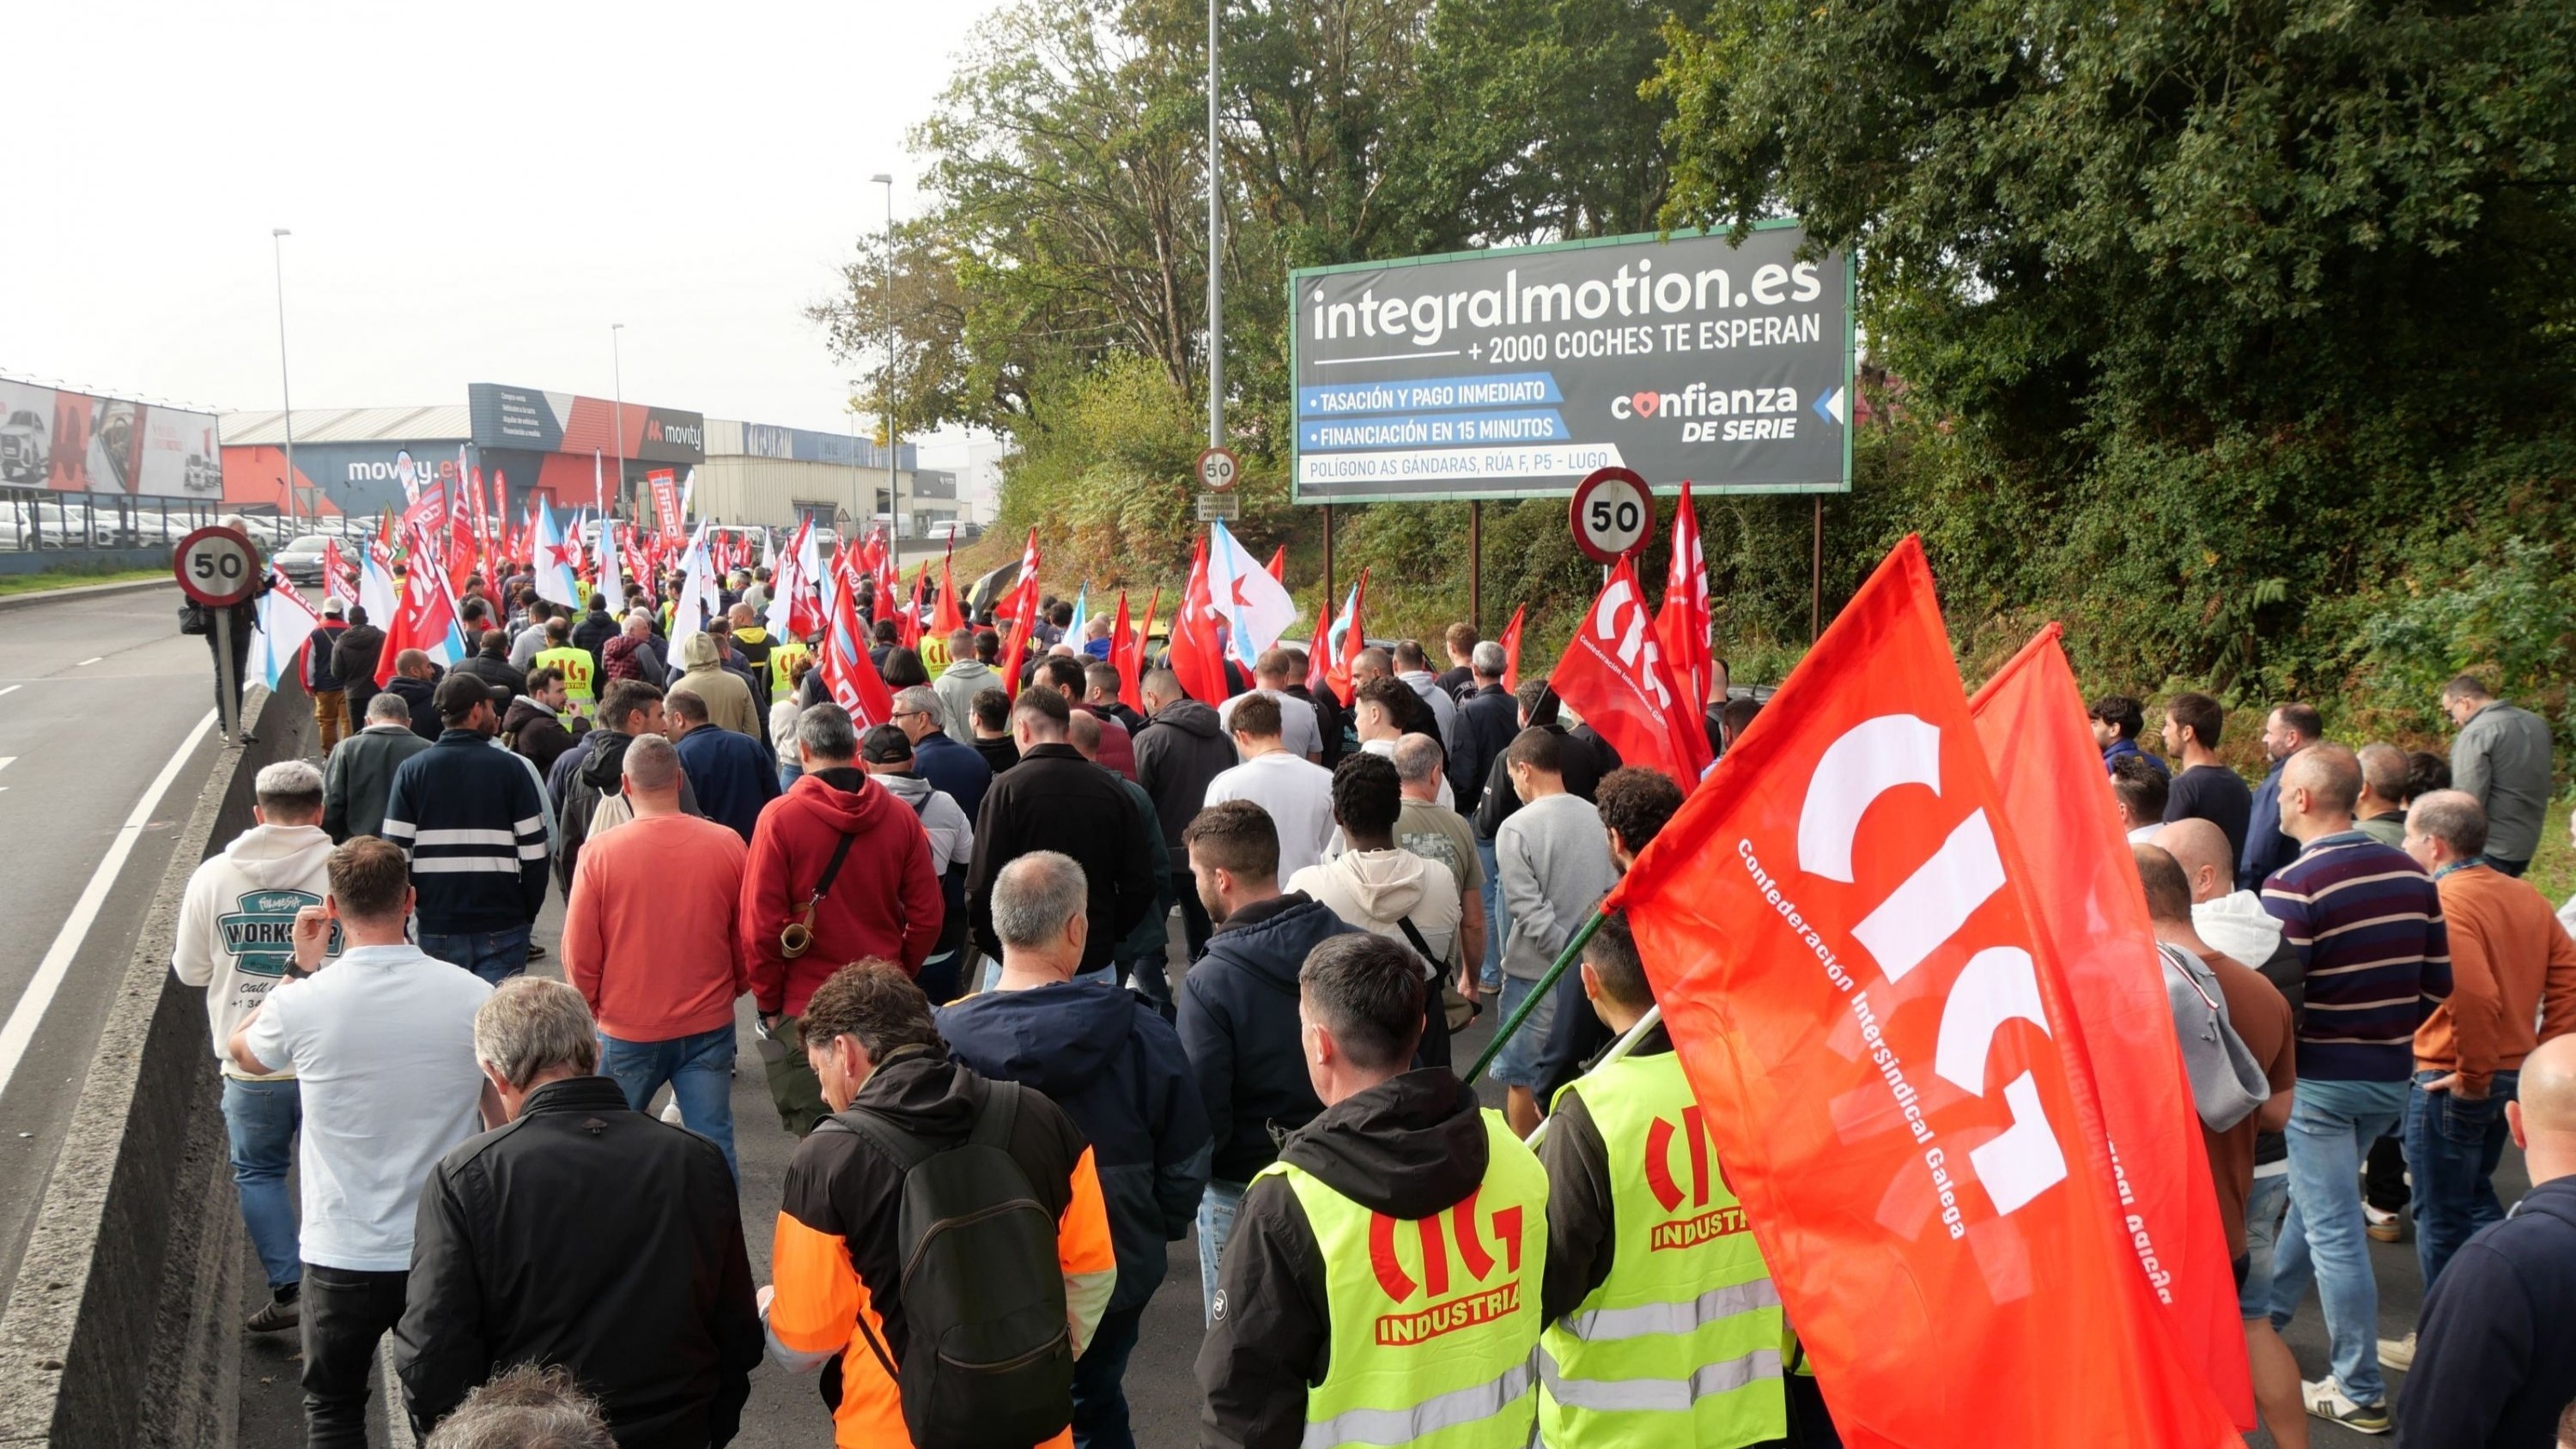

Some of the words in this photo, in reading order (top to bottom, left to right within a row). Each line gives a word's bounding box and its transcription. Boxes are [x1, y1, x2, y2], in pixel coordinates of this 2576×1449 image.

[1314, 258, 1821, 346] integralmotion.es
[1489, 334, 1546, 364] 2000
[1554, 325, 1654, 360] COCHES
[1661, 323, 1691, 352] TE
[1699, 312, 1820, 349] ESPERAN
[1320, 383, 1393, 412] TASACIÓN
[1397, 388, 1408, 408] Y
[1413, 385, 1453, 406] PAGO
[1459, 381, 1545, 404] INMEDIATO
[1612, 382, 1798, 420] confianza
[665, 424, 701, 452] movity
[1320, 419, 1427, 446] FINANCIACIÓN
[1432, 421, 1453, 442] EN
[1457, 421, 1475, 441] 15
[1479, 417, 1553, 440] MINUTOS
[1682, 421, 1717, 443] DE
[1722, 417, 1797, 441] SERIE
[1206, 462, 1230, 478] 50
[1310, 455, 1376, 477] POLÍGONO
[1381, 456, 1398, 475] AS
[1401, 454, 1481, 476] GÁNDARAS,
[1485, 451, 1515, 472] RÚA
[1519, 454, 1529, 473] F,
[1534, 452, 1553, 470] P5
[1568, 452, 1608, 470] LUGO
[1591, 500, 1638, 533] 50
[195, 553, 241, 579] 50
[226, 923, 338, 944] WORKP
[1798, 713, 2068, 1217] CIG
[240, 982, 269, 993] Call
[1738, 838, 1854, 992] Confederación
[1851, 991, 1935, 1145] Intersindical
[1925, 1147, 1965, 1240] Galega
[1369, 1185, 1523, 1305] CIG
[1380, 1282, 1520, 1343] INDUSTRIA
